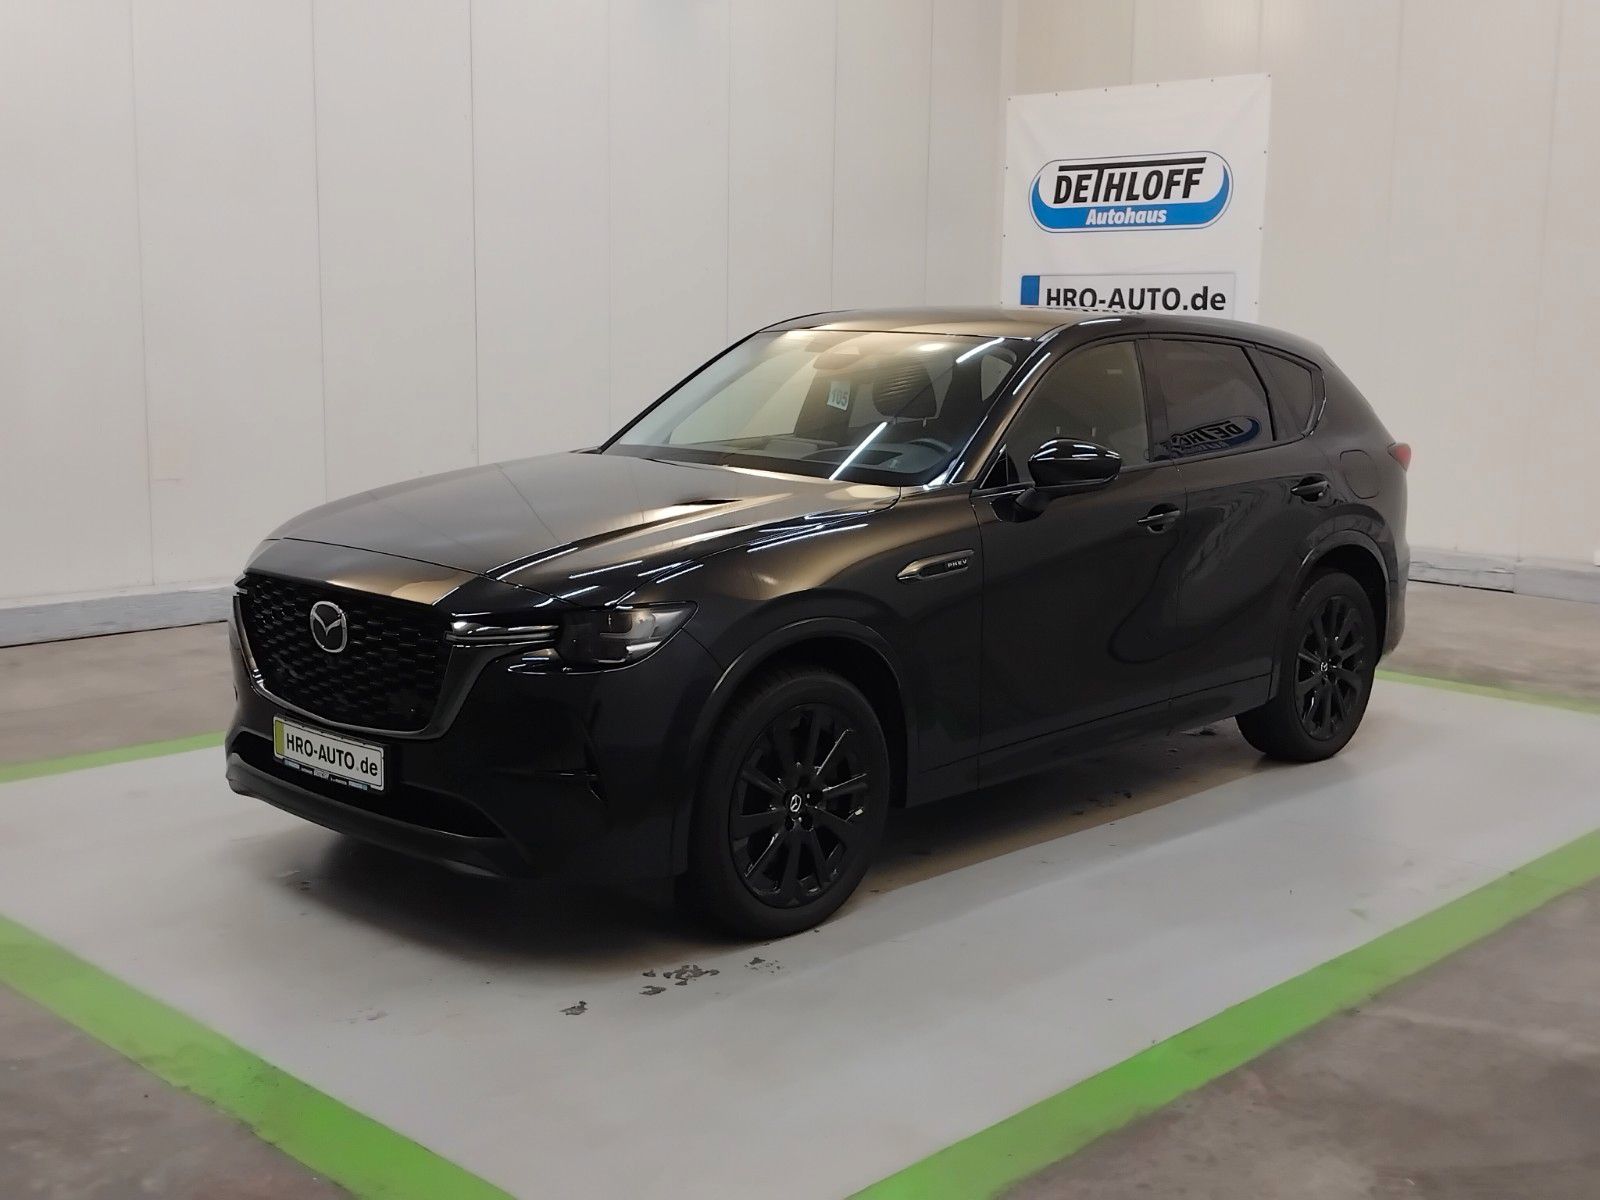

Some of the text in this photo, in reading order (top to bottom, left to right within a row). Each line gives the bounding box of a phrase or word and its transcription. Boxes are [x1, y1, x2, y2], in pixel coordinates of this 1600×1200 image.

[1053, 157, 1207, 204] DETHLOFF
[1085, 207, 1168, 226] Autohaus
[1046, 286, 1226, 311] HRO-AUTO.de
[947, 559, 967, 568] PHEV
